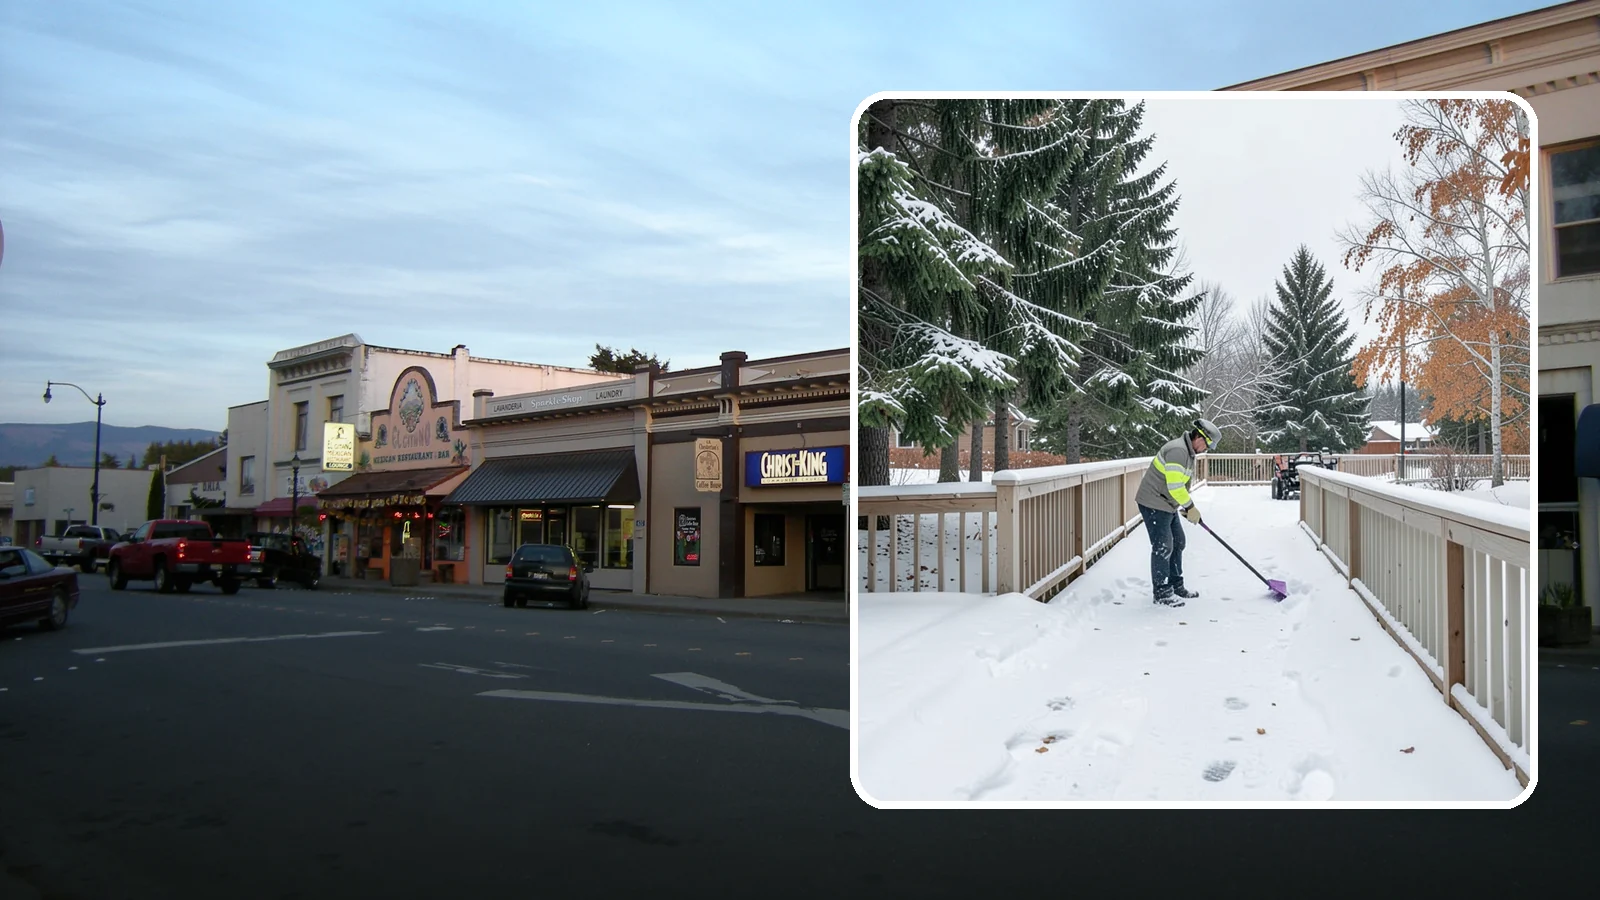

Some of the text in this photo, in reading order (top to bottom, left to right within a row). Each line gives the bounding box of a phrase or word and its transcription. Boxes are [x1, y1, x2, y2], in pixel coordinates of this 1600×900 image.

[531, 394, 583, 409] Sparkle Shop
[595, 389, 624, 400] LAUNDRY
[493, 402, 523, 412] LAVANDERIA
[373, 450, 450, 464] MEXICAN RESTAURANT BAR
[761, 450, 827, 478] CHRIST KING
